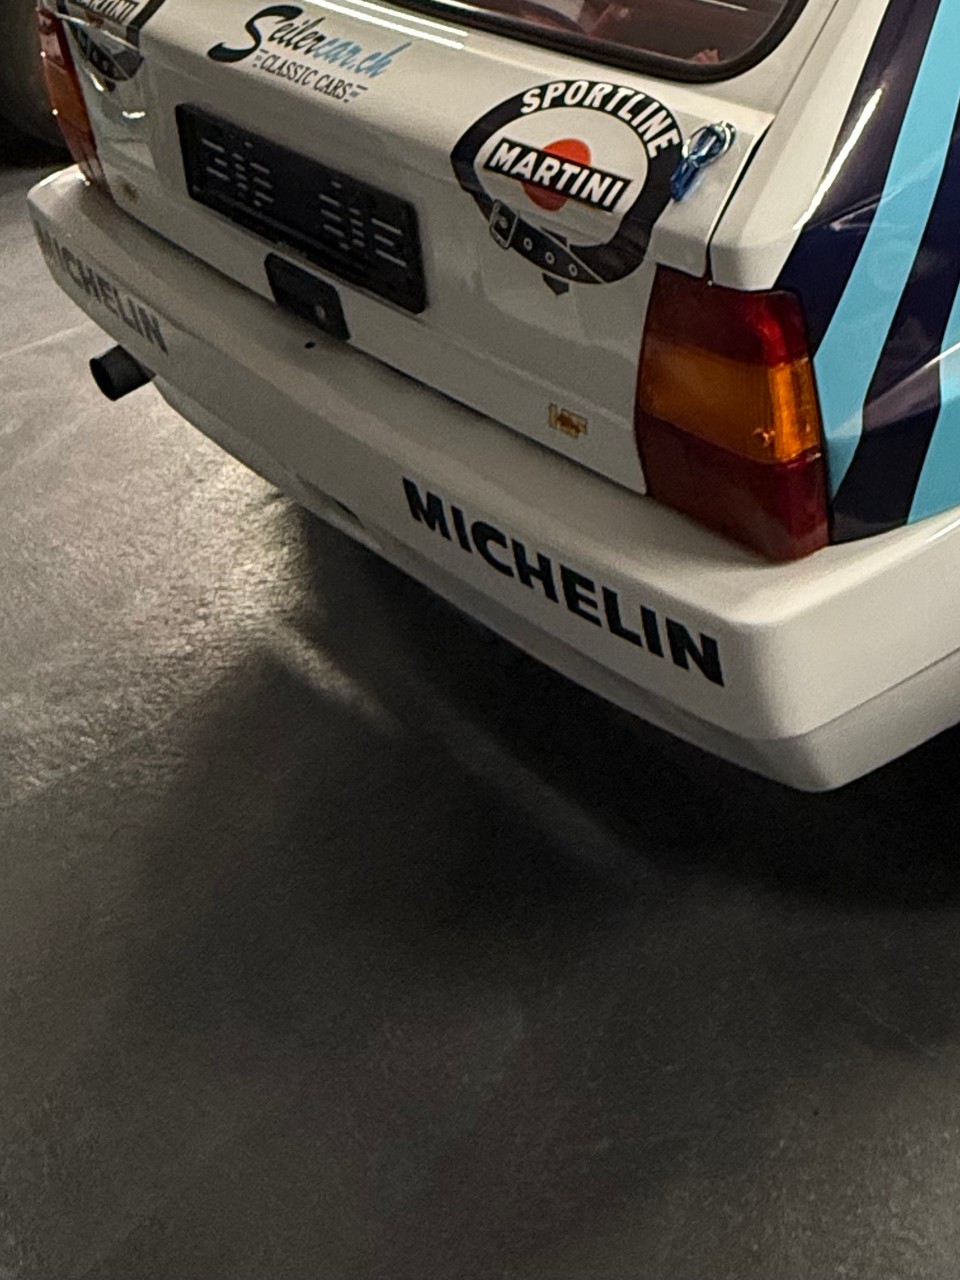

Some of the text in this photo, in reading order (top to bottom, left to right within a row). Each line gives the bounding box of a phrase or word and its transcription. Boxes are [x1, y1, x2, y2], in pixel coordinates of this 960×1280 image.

[259, 53, 353, 101] CLASSIC CARS
[520, 79, 681, 159] SPORTLINE
[489, 141, 624, 209] MARTINI
[402, 475, 725, 687] MICHELIN
